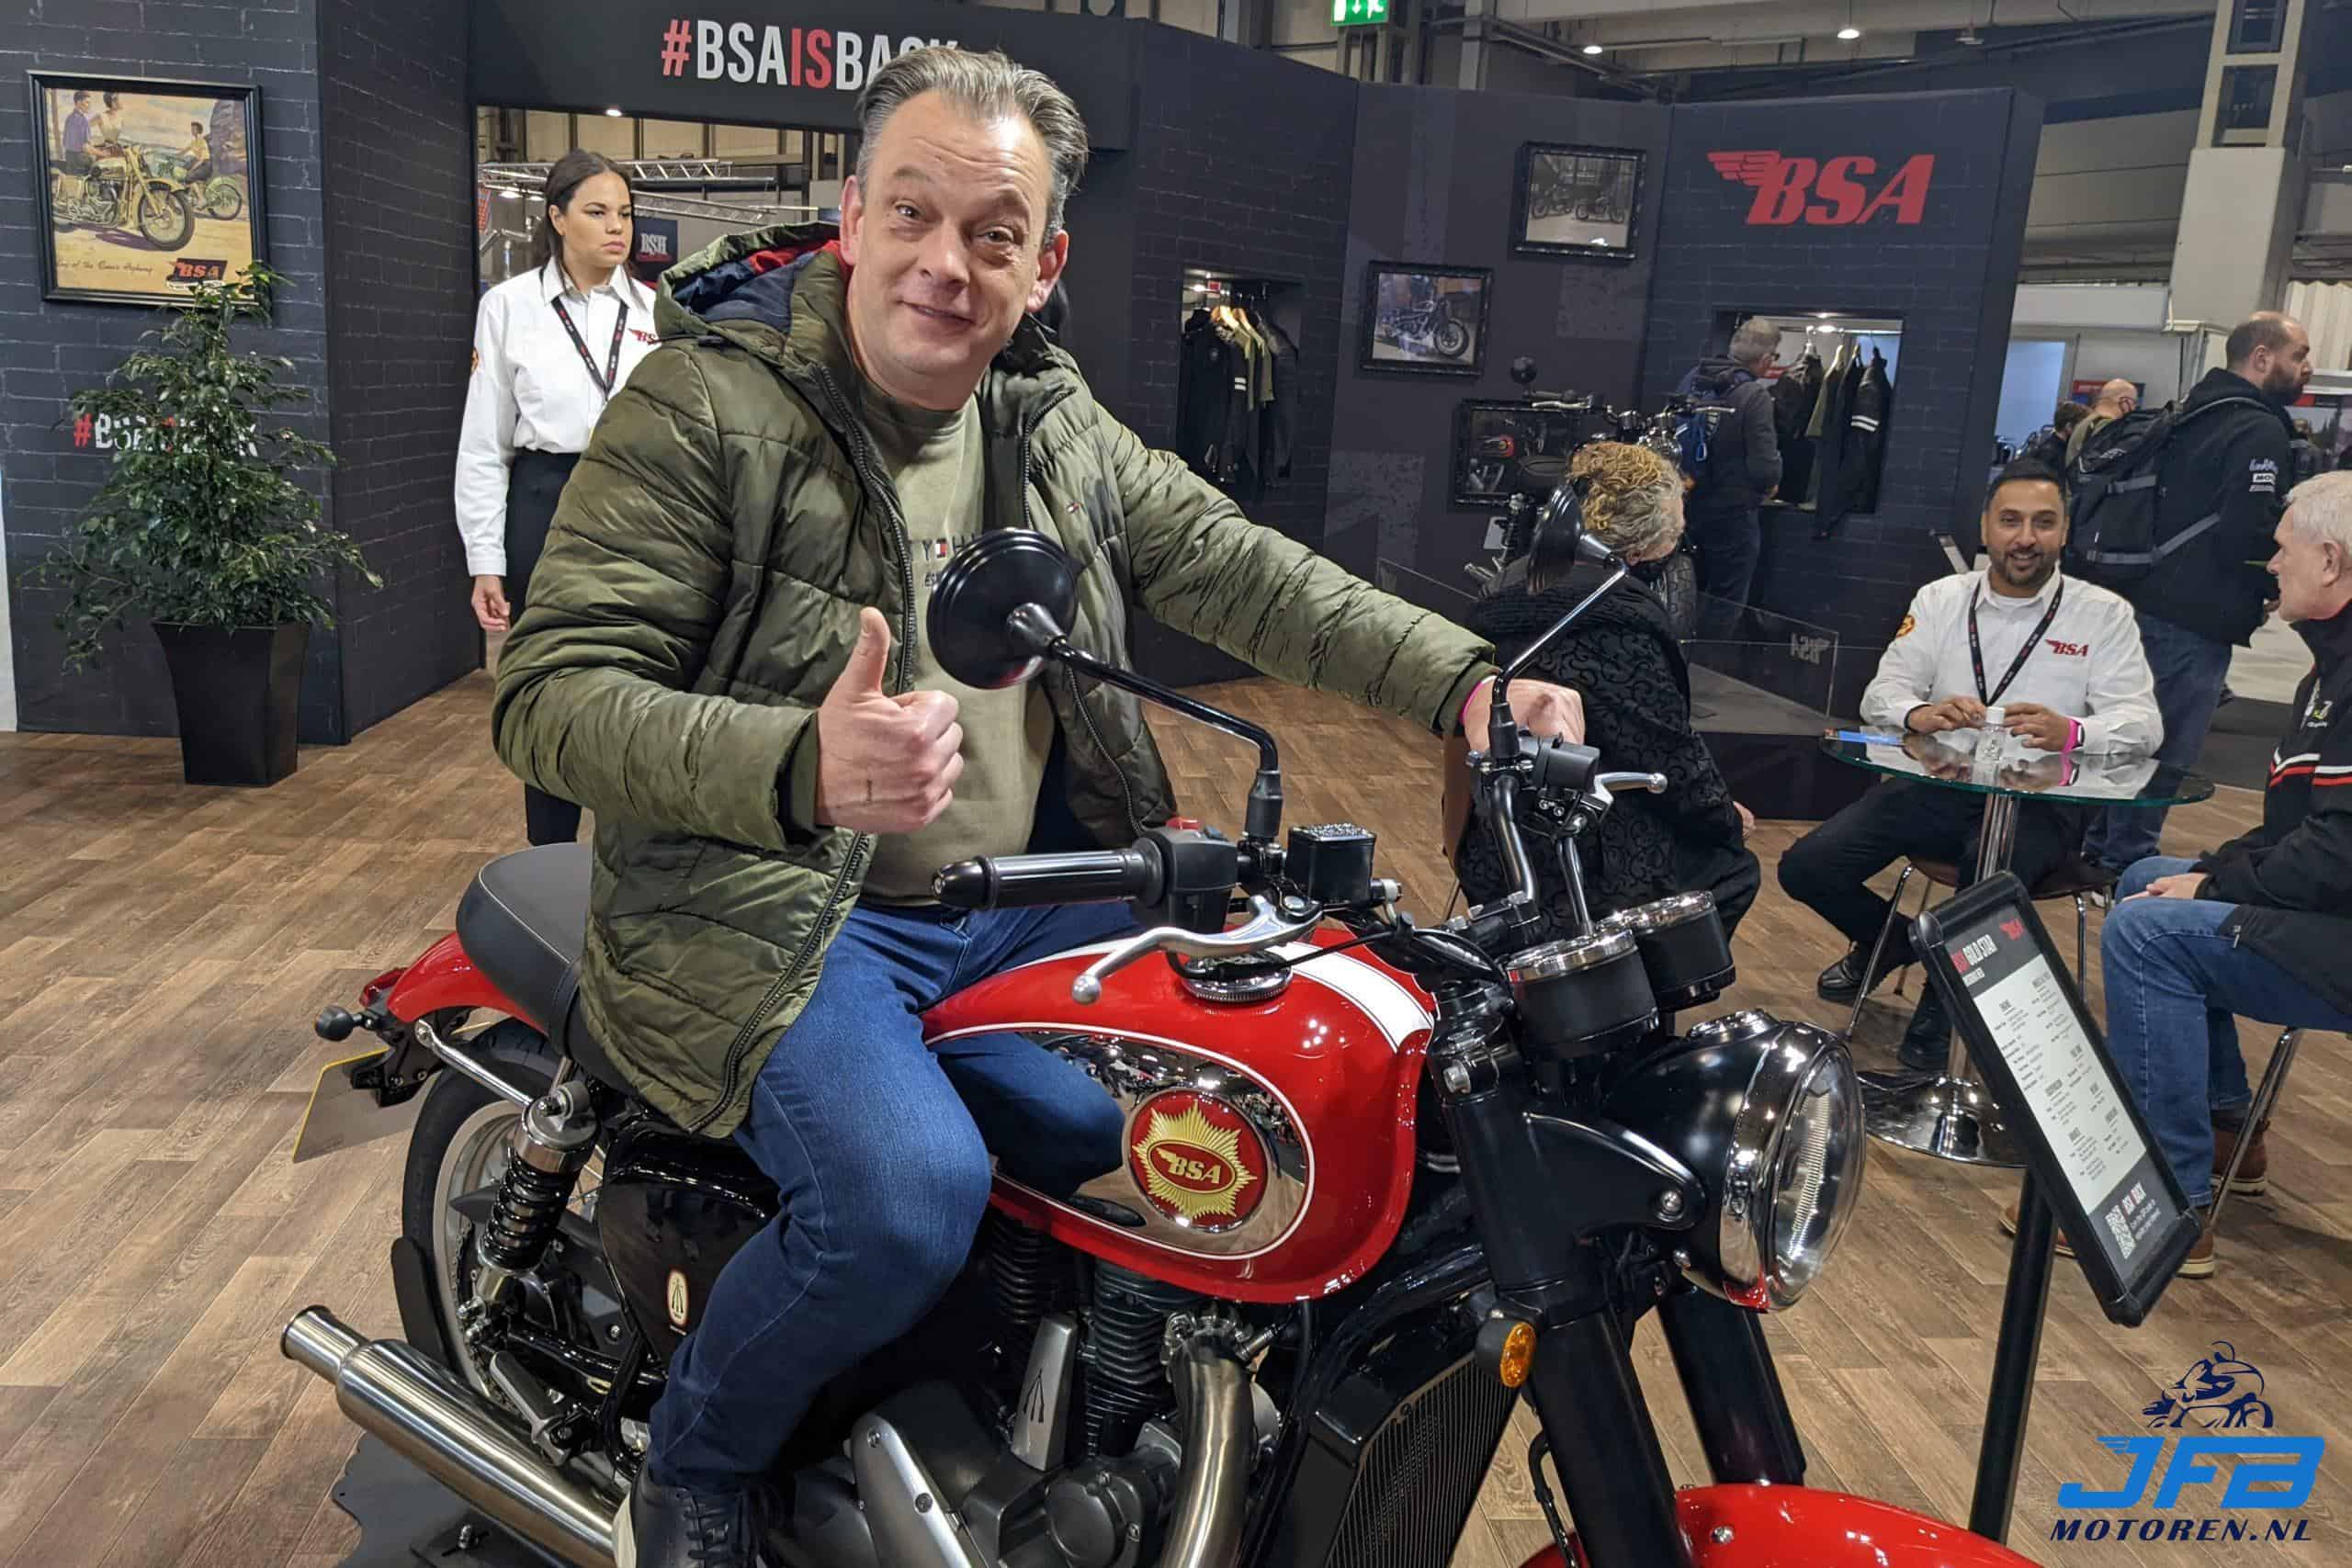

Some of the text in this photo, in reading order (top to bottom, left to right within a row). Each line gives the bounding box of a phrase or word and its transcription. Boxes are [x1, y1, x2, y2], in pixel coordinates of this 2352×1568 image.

[661, 18, 959, 91] #BSAISBA
[1736, 151, 1936, 225] BSA
[175, 261, 220, 278] BSA
[2049, 640, 2089, 657] BSA
[1163, 1152, 1222, 1184] BSA
